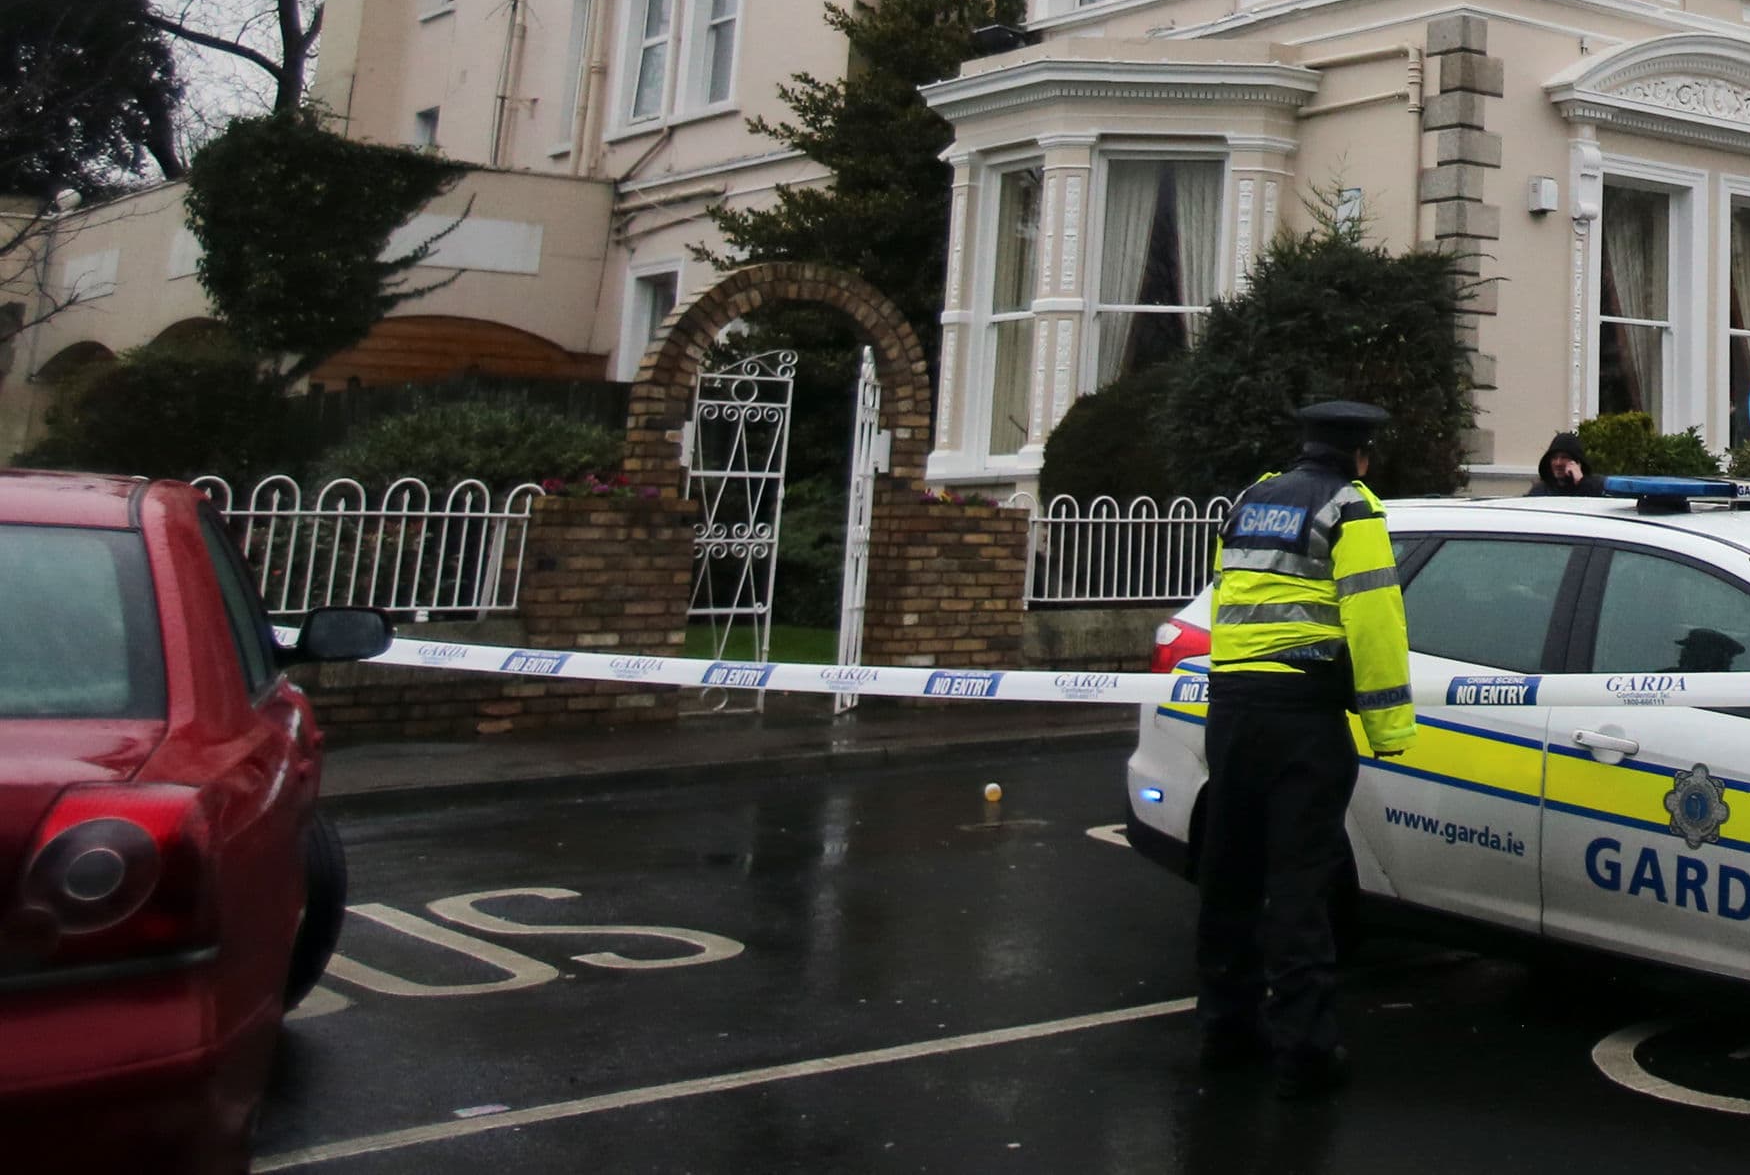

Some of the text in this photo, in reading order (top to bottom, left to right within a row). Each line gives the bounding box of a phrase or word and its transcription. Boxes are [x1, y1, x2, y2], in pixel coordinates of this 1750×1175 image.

[1240, 508, 1302, 535] GARDA
[418, 644, 468, 658] GARDA
[508, 656, 560, 674] NO ENTRY
[609, 658, 665, 672] GARDA
[820, 666, 879, 682] GARDA
[708, 668, 766, 686] NO ENTRY
[1054, 674, 1119, 688] GARDA
[1606, 675, 1687, 691] GARDA
[931, 677, 993, 696] NO ENTRY
[1180, 683, 1200, 702] NO
[1456, 685, 1529, 705] NO ENTRY
[1357, 686, 1410, 706] GARDA
[1385, 805, 1524, 857] www.garda.ie
[284, 887, 745, 1022] US
